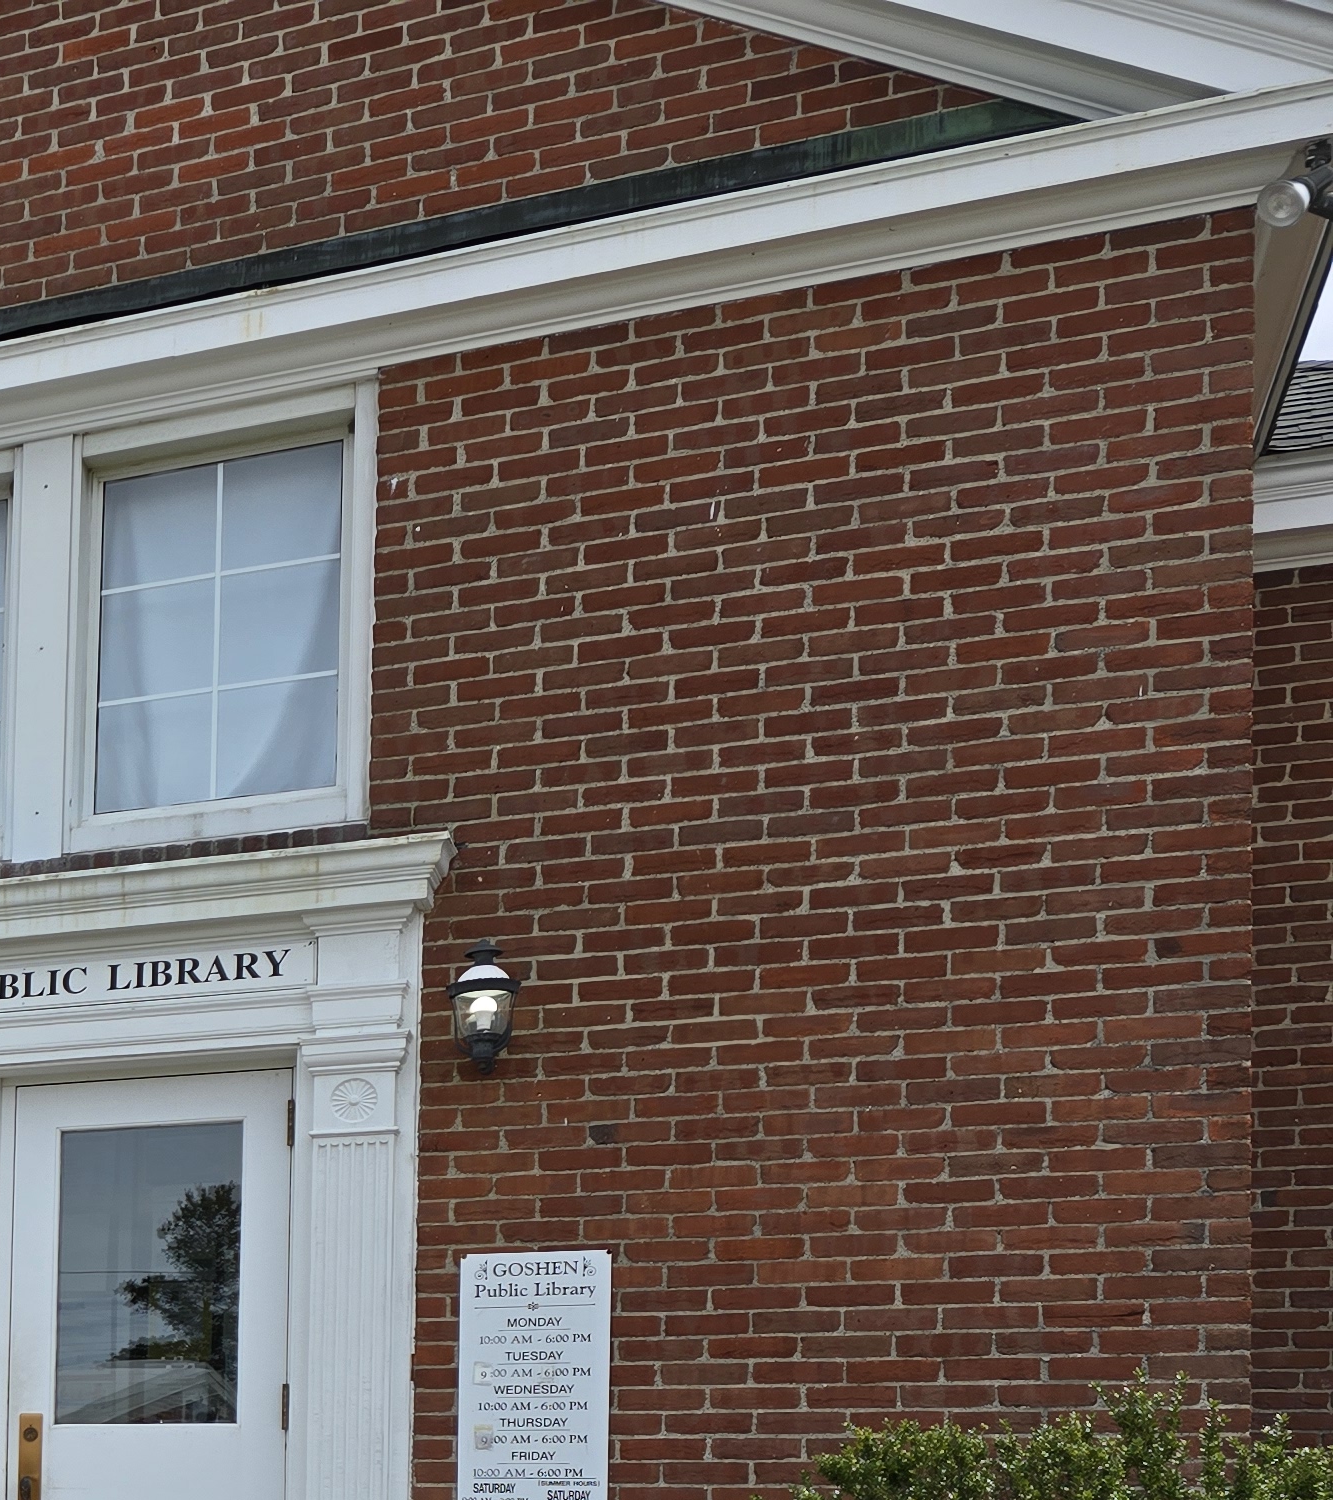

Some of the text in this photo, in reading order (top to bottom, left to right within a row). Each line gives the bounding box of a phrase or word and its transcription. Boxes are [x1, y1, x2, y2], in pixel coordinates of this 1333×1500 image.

[107, 948, 291, 991] LIBRARY
[492, 1260, 579, 1277] GOSHEN
[474, 1281, 597, 1298] Public Library
[507, 1316, 563, 1328] MONDAY
[479, 1335, 507, 1345] 10:00
[511, 1335, 533, 1344] AM
[545, 1333, 569, 1343] 6:00
[572, 1333, 592, 1343] PM
[505, 1351, 564, 1361] TUESDAY
[511, 1368, 533, 1378] AM
[544, 1367, 569, 1377] 6:00
[572, 1367, 592, 1377] PM
[493, 1384, 575, 1395] WEDNESDAY
[478, 1401, 507, 1411] 10:00
[510, 1401, 531, 1411] AM
[540, 1401, 566, 1411] 6:00
[569, 1401, 589, 1411] PM
[499, 1417, 569, 1428] THURSDAY
[510, 1435, 531, 1444] AM
[541, 1434, 566, 1444] 6:00
[569, 1434, 589, 1444] PM
[511, 1451, 556, 1461] FRIDAY
[473, 1468, 500, 1477] 10:00
[504, 1468, 526, 1477] AM
[537, 1468, 561, 1477] 6:00
[564, 1468, 584, 1477] PM
[473, 1482, 516, 1494] SATURDAY
[546, 1489, 591, 1500] SATURDAY
